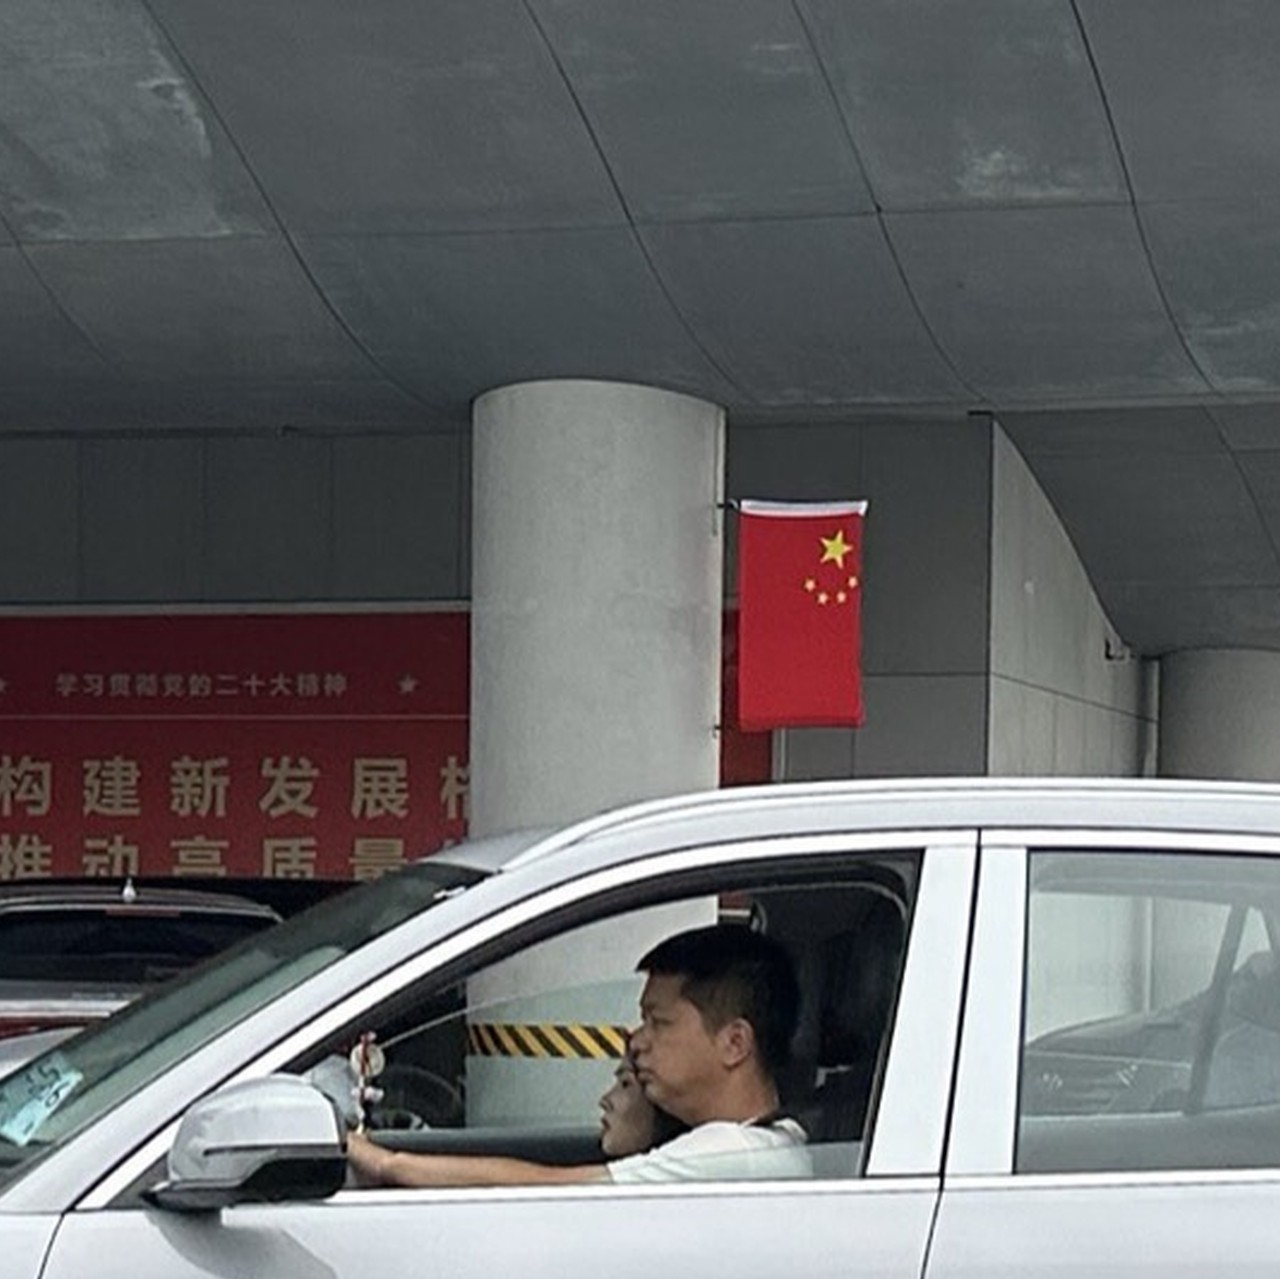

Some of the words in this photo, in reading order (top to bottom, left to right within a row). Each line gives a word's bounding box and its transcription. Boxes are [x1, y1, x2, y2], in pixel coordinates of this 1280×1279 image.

[56, 672, 348, 697] 学习贯彻党的二十大精神
